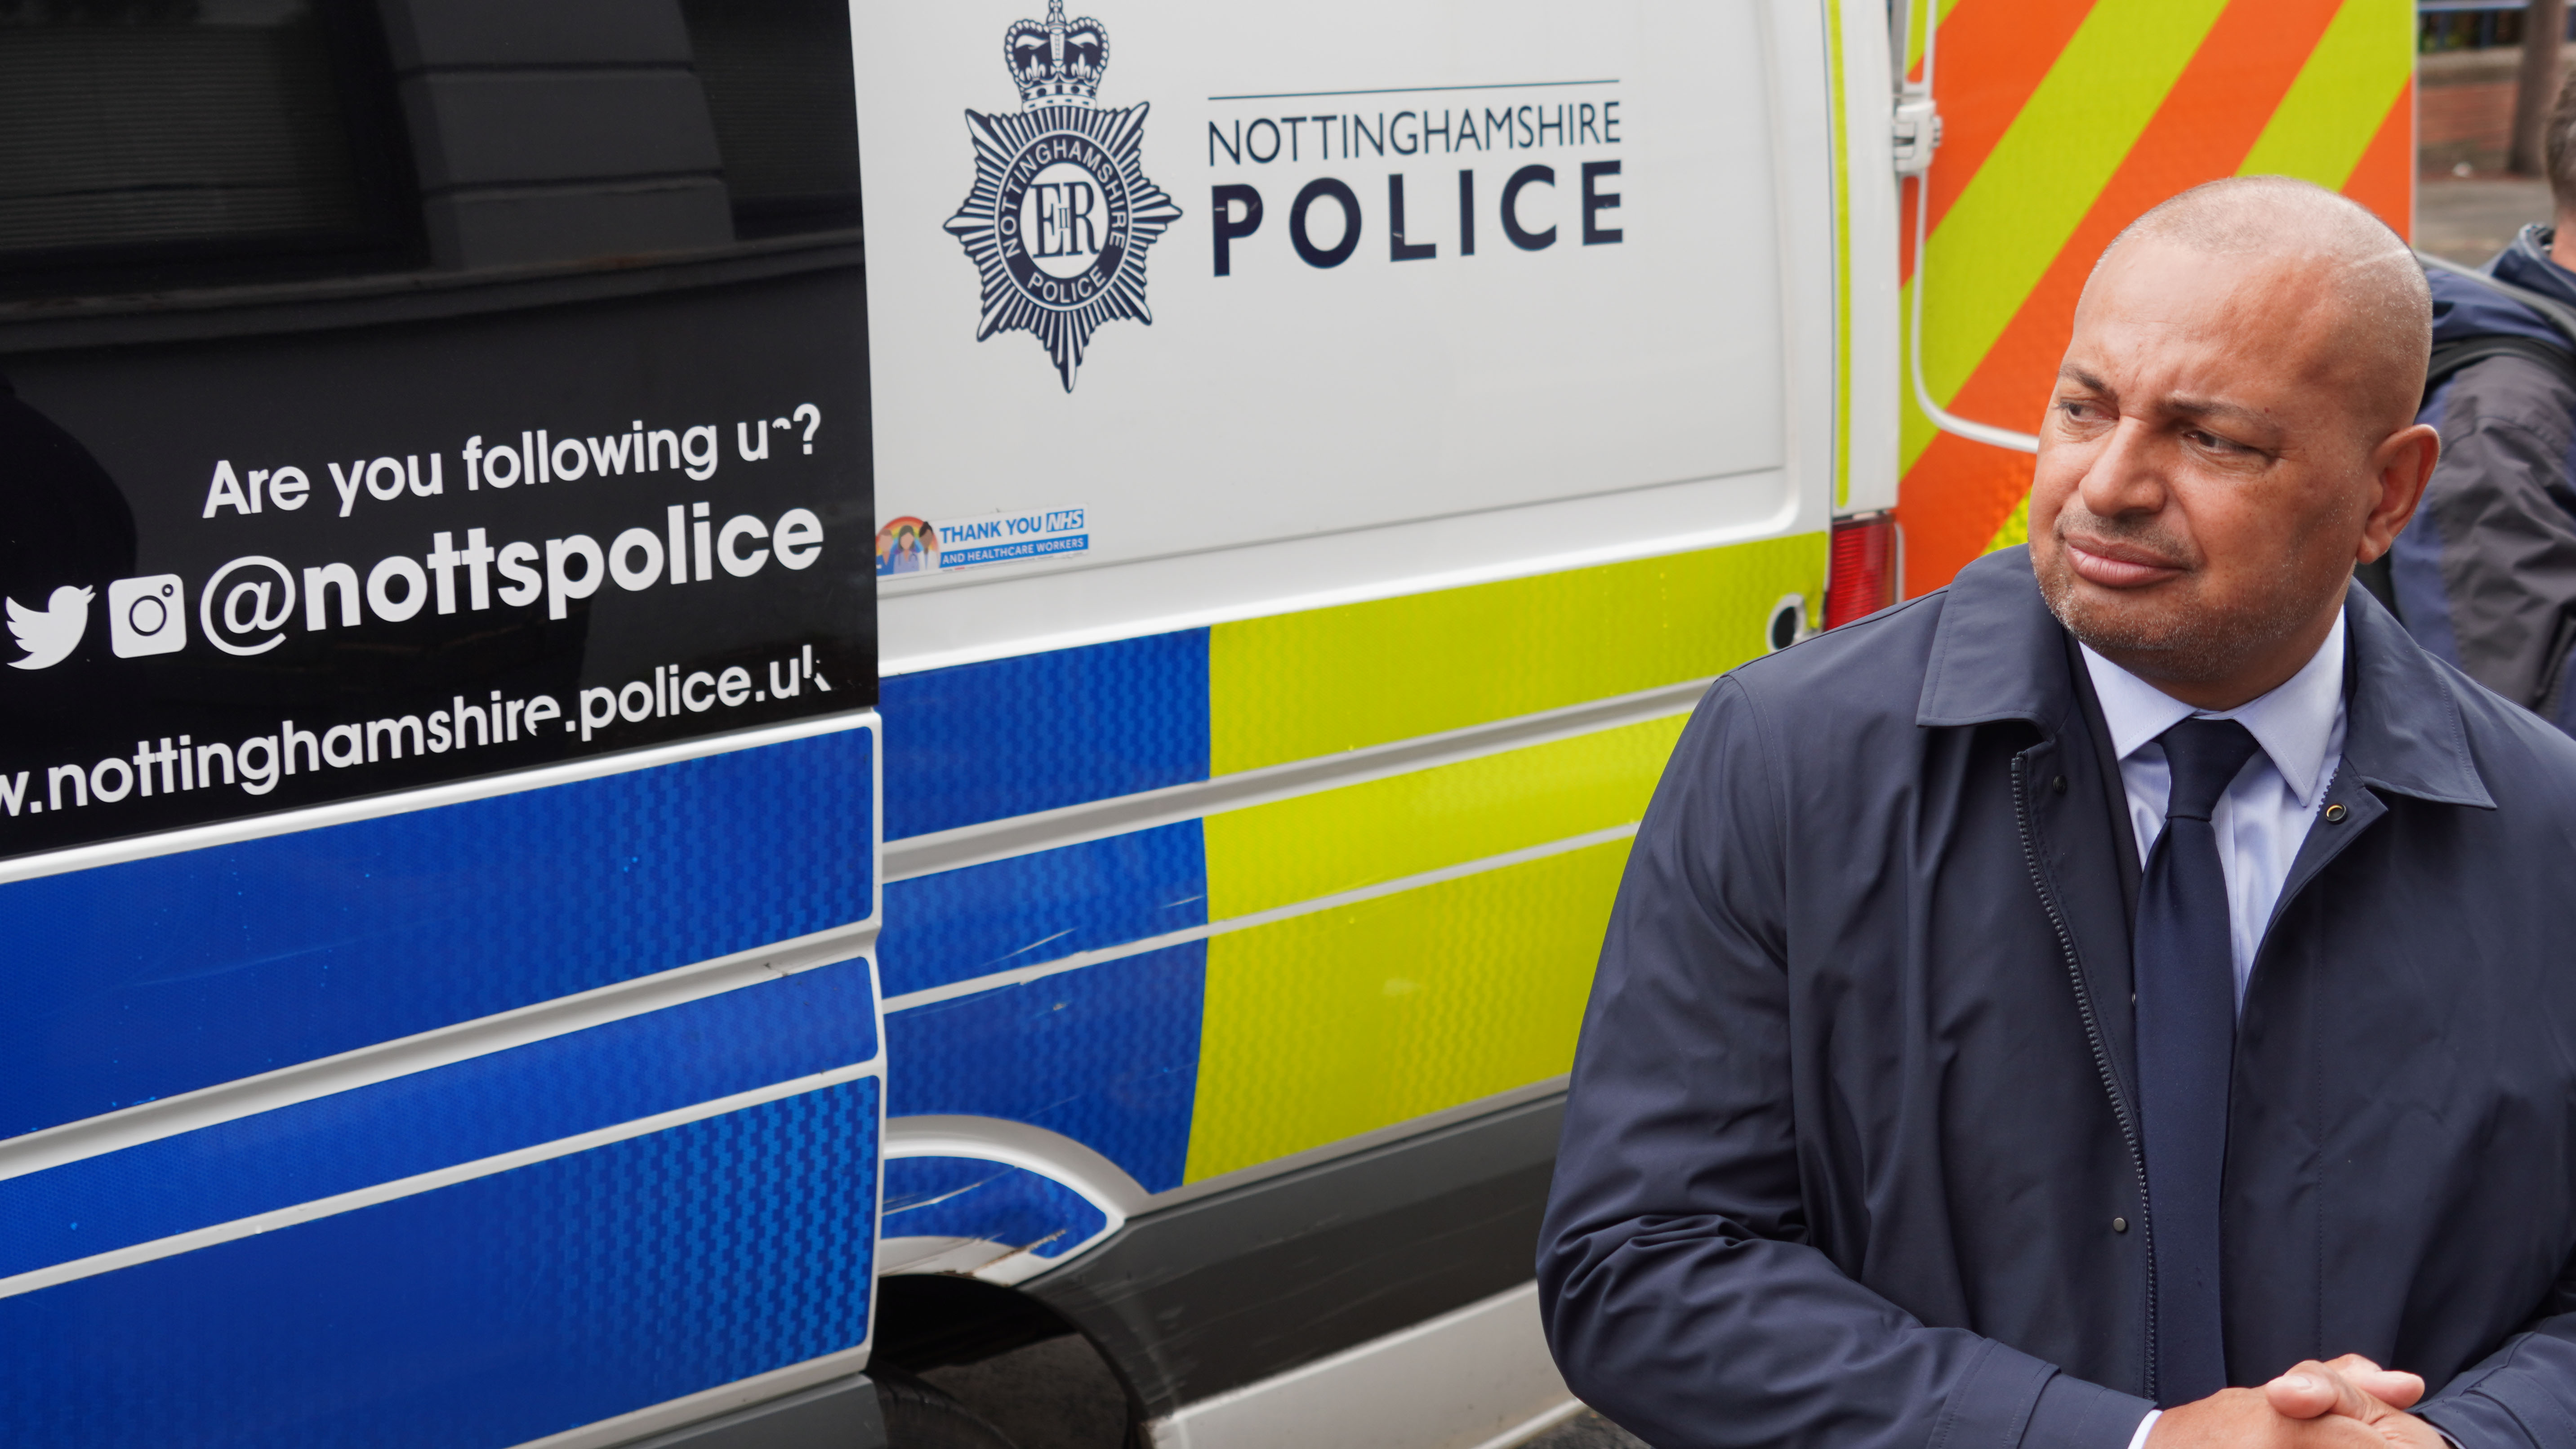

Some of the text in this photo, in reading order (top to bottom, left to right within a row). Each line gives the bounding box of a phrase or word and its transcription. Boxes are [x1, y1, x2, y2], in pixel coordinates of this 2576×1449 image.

[1208, 101, 1621, 167] NOTTINGHAMSHIRE
[1000, 139, 1127, 259] NOTTINGHAMSHIRE
[1211, 159, 1623, 277] POLICE
[1027, 266, 1107, 304] POLICE
[202, 403, 821, 519] Are you following u?
[939, 509, 1084, 544] THANK YOU NHS
[942, 552, 966, 566] AND
[967, 544, 1034, 562] HEALTHCARE
[1036, 537, 1084, 552] WORKERS
[199, 501, 824, 656] @nottspolice
